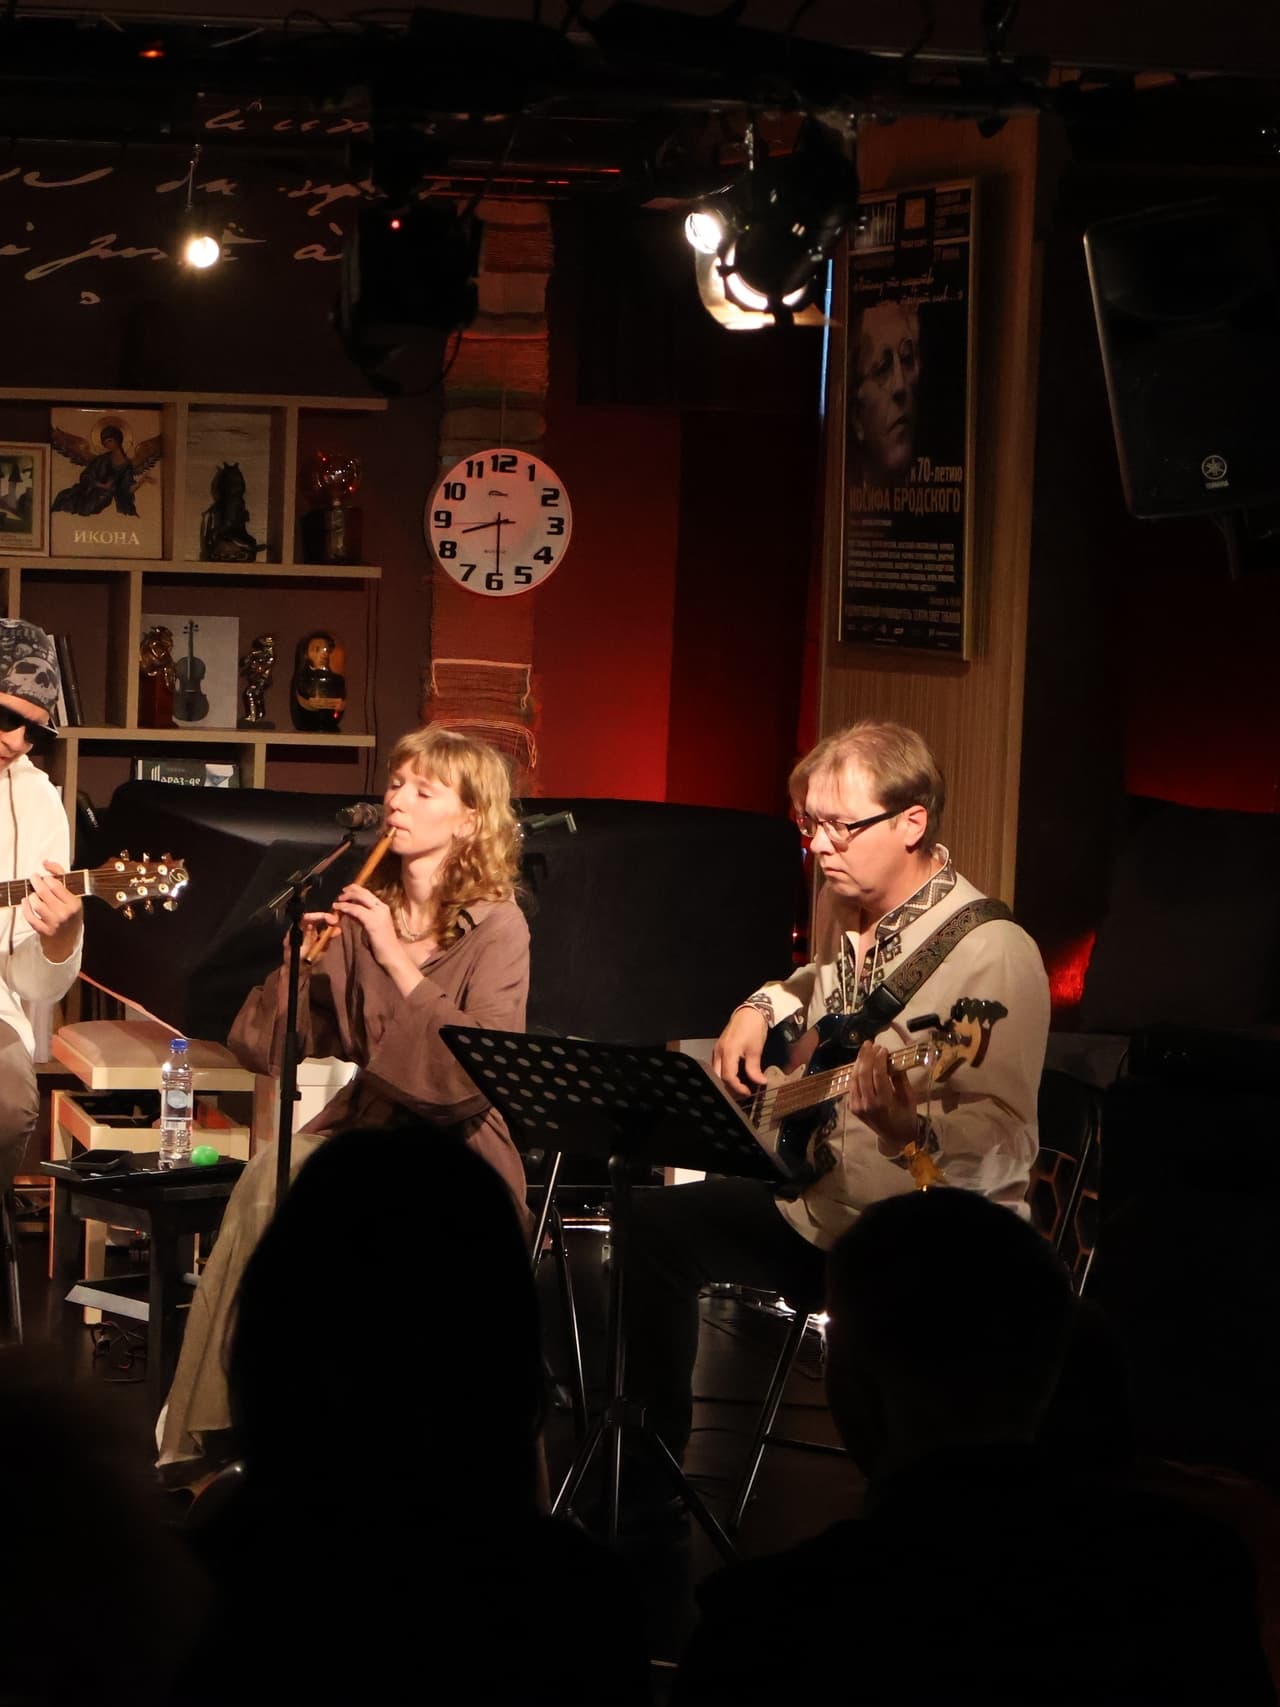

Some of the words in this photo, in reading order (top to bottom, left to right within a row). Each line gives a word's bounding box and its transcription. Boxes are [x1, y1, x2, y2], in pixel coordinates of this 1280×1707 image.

[466, 460, 484, 478] 11
[491, 454, 518, 473] 12
[528, 464, 535, 481] 1
[444, 482, 466, 500] 10
[541, 488, 560, 507] 2
[893, 487, 961, 519] БРОДСКОГО
[434, 510, 452, 528] 9
[547, 517, 564, 535] 3
[73, 530, 140, 545] ИКОНА
[439, 540, 457, 559] 8
[534, 546, 553, 564] 4
[460, 563, 476, 581] 7
[514, 566, 533, 584] 5
[485, 572, 503, 591] 6
